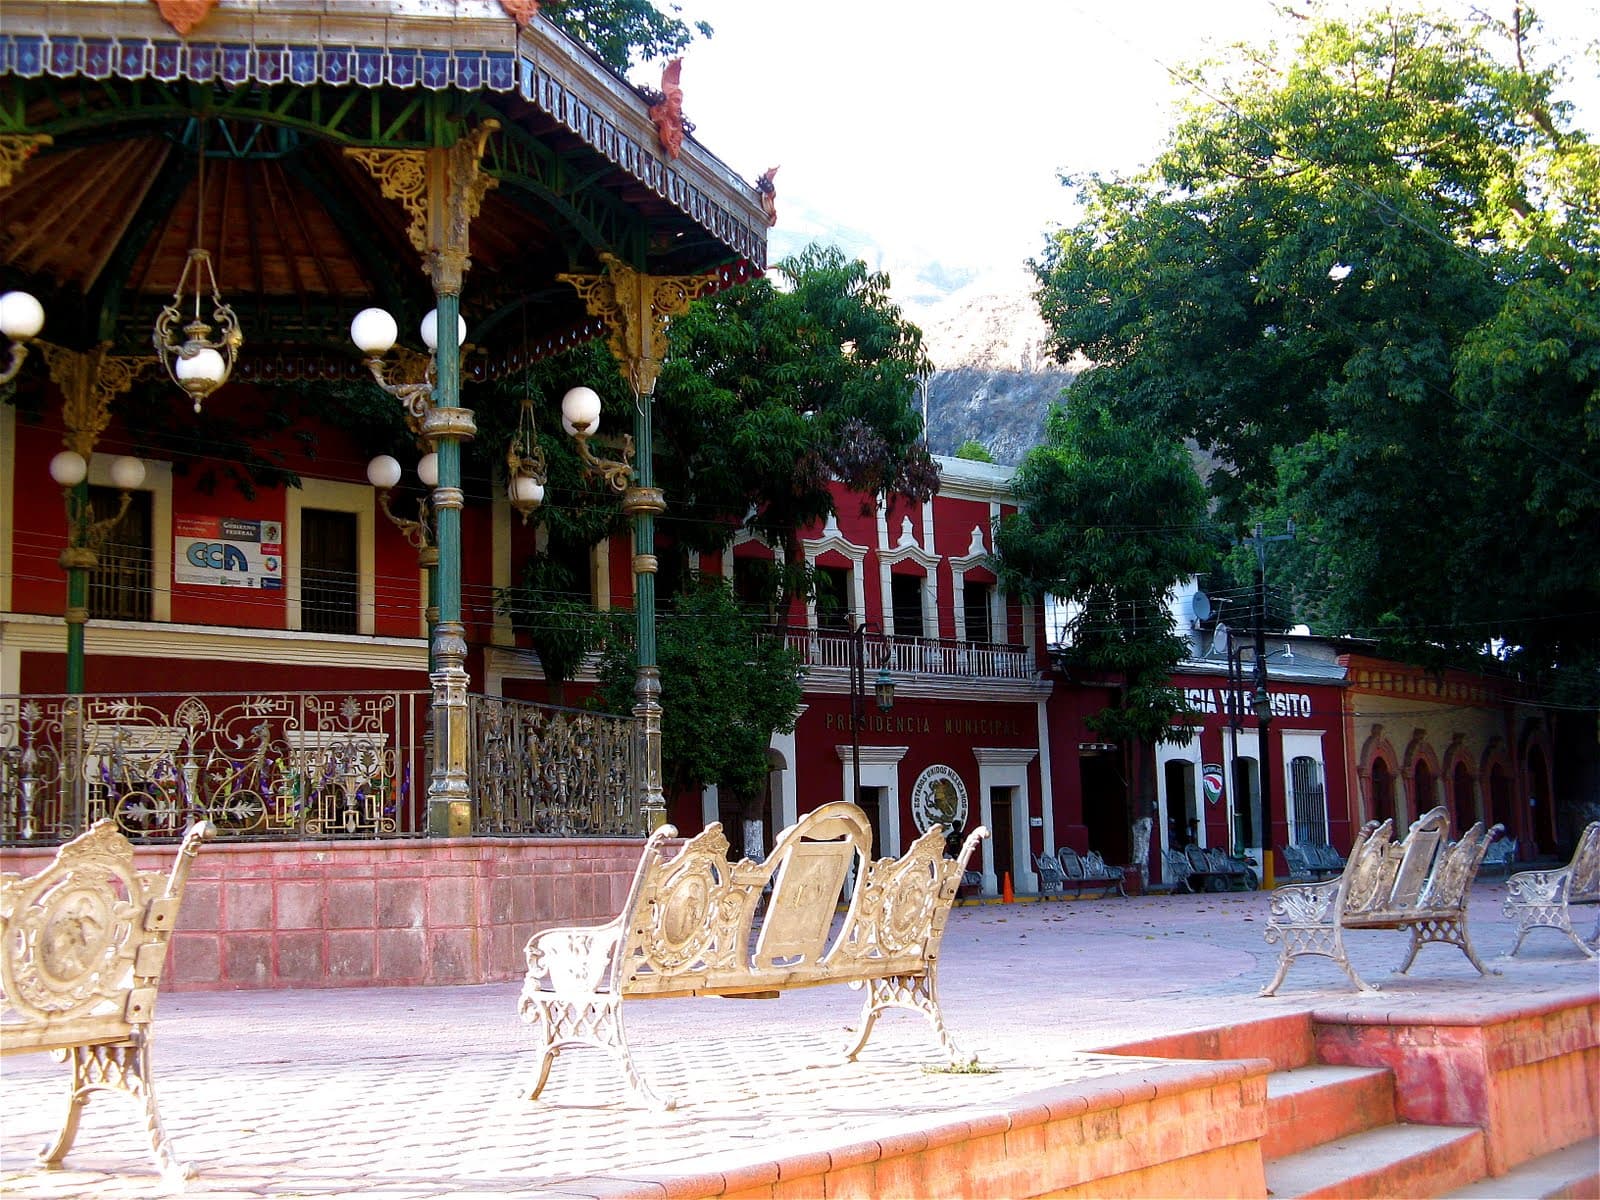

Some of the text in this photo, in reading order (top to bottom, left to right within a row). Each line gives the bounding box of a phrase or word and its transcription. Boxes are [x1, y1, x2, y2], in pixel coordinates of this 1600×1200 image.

[223, 521, 257, 531] GOBIERNO
[1233, 690, 1311, 718] TRNSITO
[945, 718, 1020, 736] MUNICIPAL
[914, 766, 968, 809] ESTADOS UNIDOS MEXICANOS
